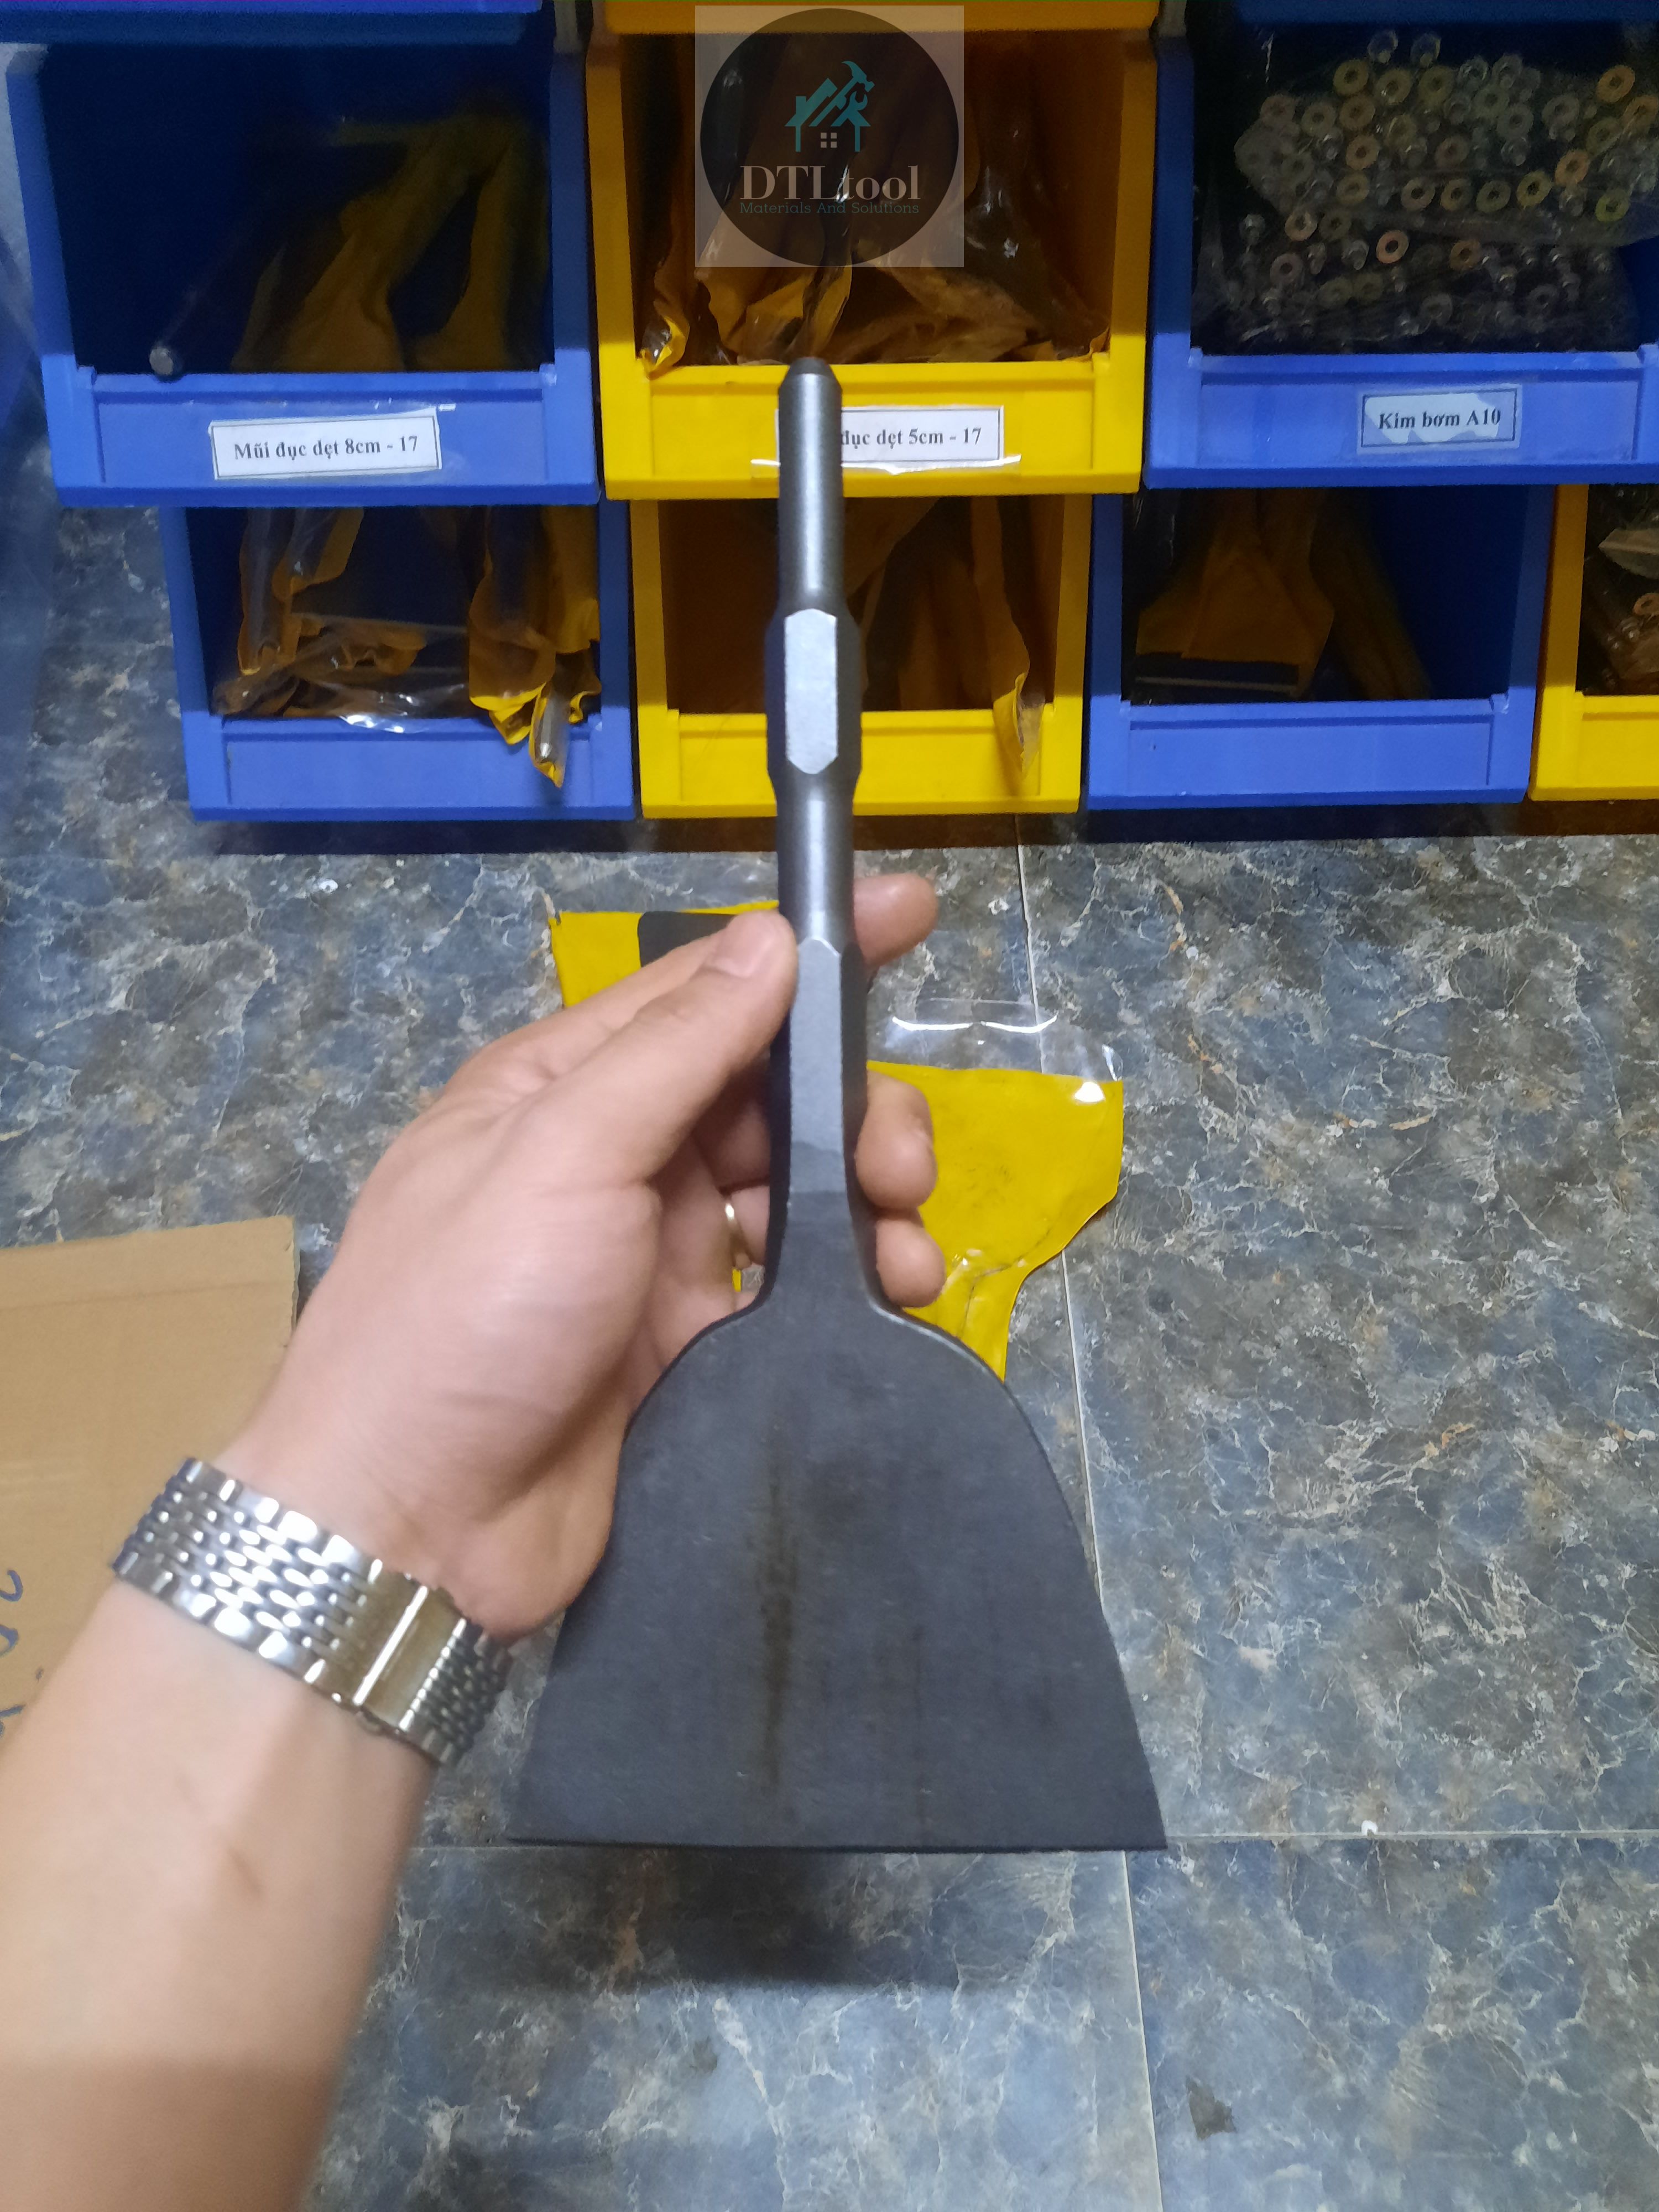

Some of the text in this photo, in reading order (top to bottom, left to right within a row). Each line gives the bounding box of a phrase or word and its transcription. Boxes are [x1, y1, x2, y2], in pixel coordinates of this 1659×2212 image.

[1379, 408, 1501, 430] Kim bơm A10
[234, 441, 270, 460] Mũi
[312, 438, 339, 460] dẹt
[345, 437, 380, 455] 8cm
[400, 435, 418, 452] 17
[876, 429, 902, 449] dẹt
[909, 427, 943, 445] 5cm
[963, 426, 982, 445] 17
